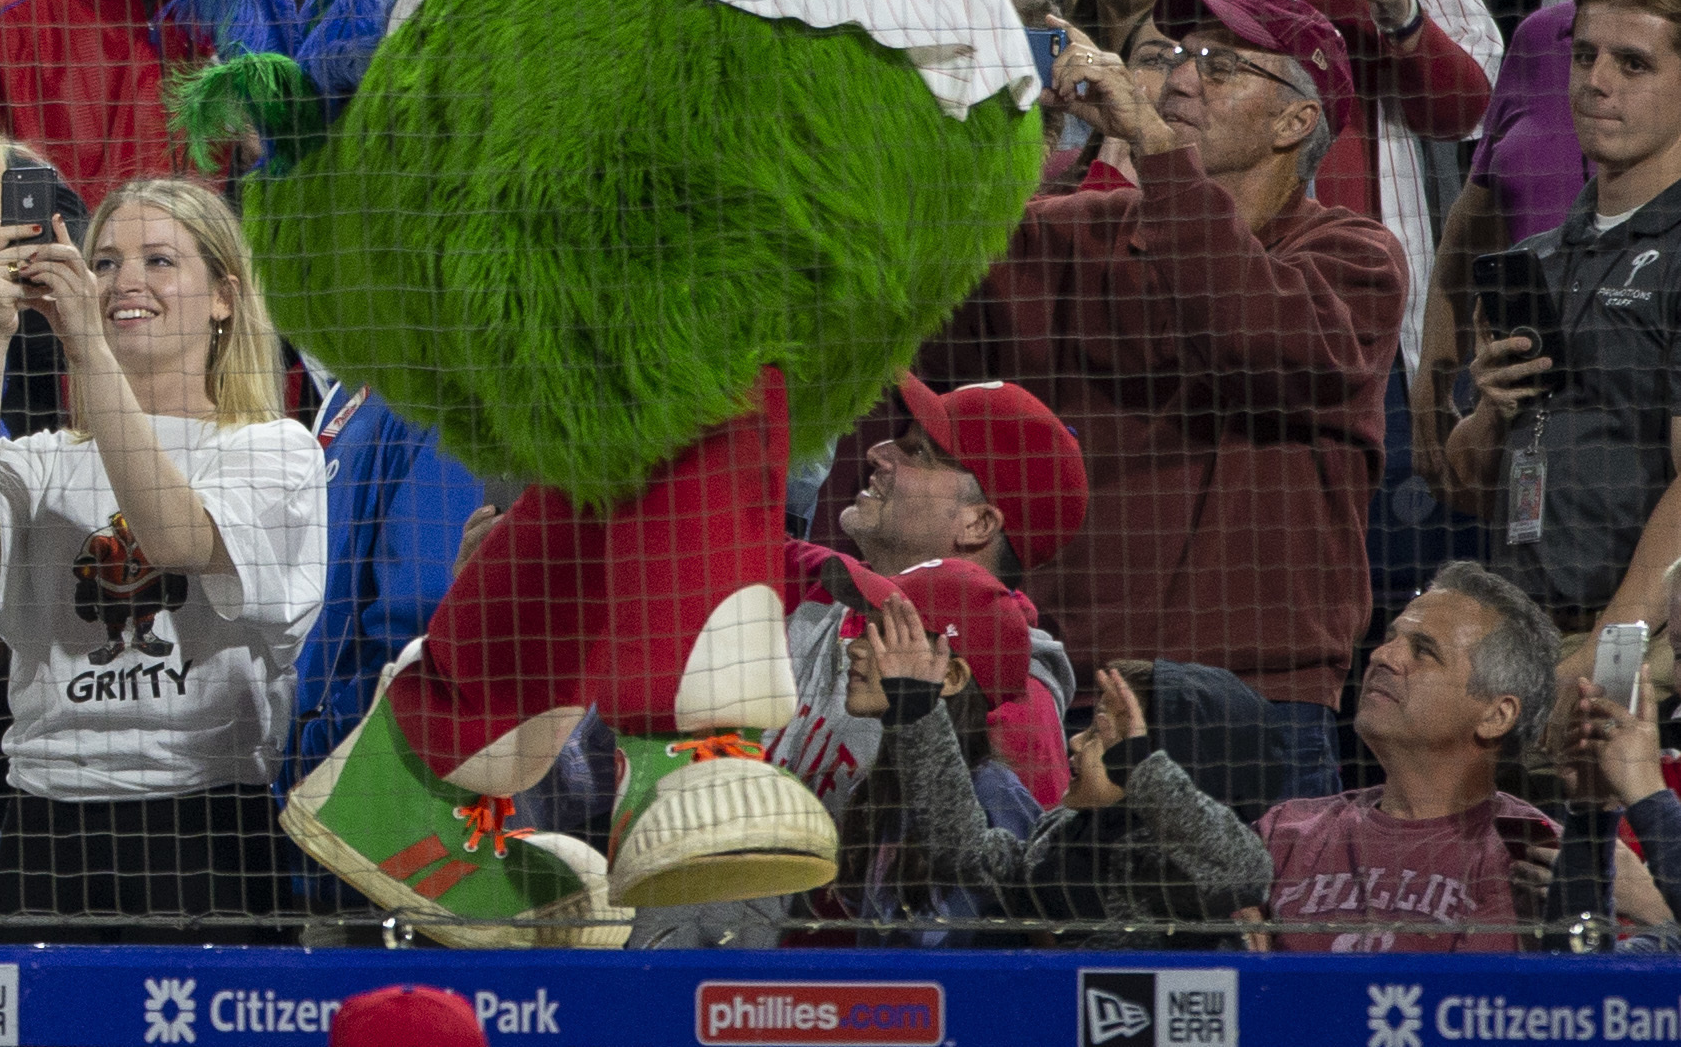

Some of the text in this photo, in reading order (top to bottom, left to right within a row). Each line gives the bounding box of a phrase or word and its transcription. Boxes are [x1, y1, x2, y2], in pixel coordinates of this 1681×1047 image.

[66, 659, 193, 703] GRITTY
[1273, 867, 1478, 927] PHILLIE
[475, 988, 559, 1033] Park
[709, 995, 930, 1037] phillies.com
[1169, 991, 1225, 1015] NEW
[1435, 994, 1681, 1041] Citizens Ban
[1169, 1018, 1225, 1043] ERA
